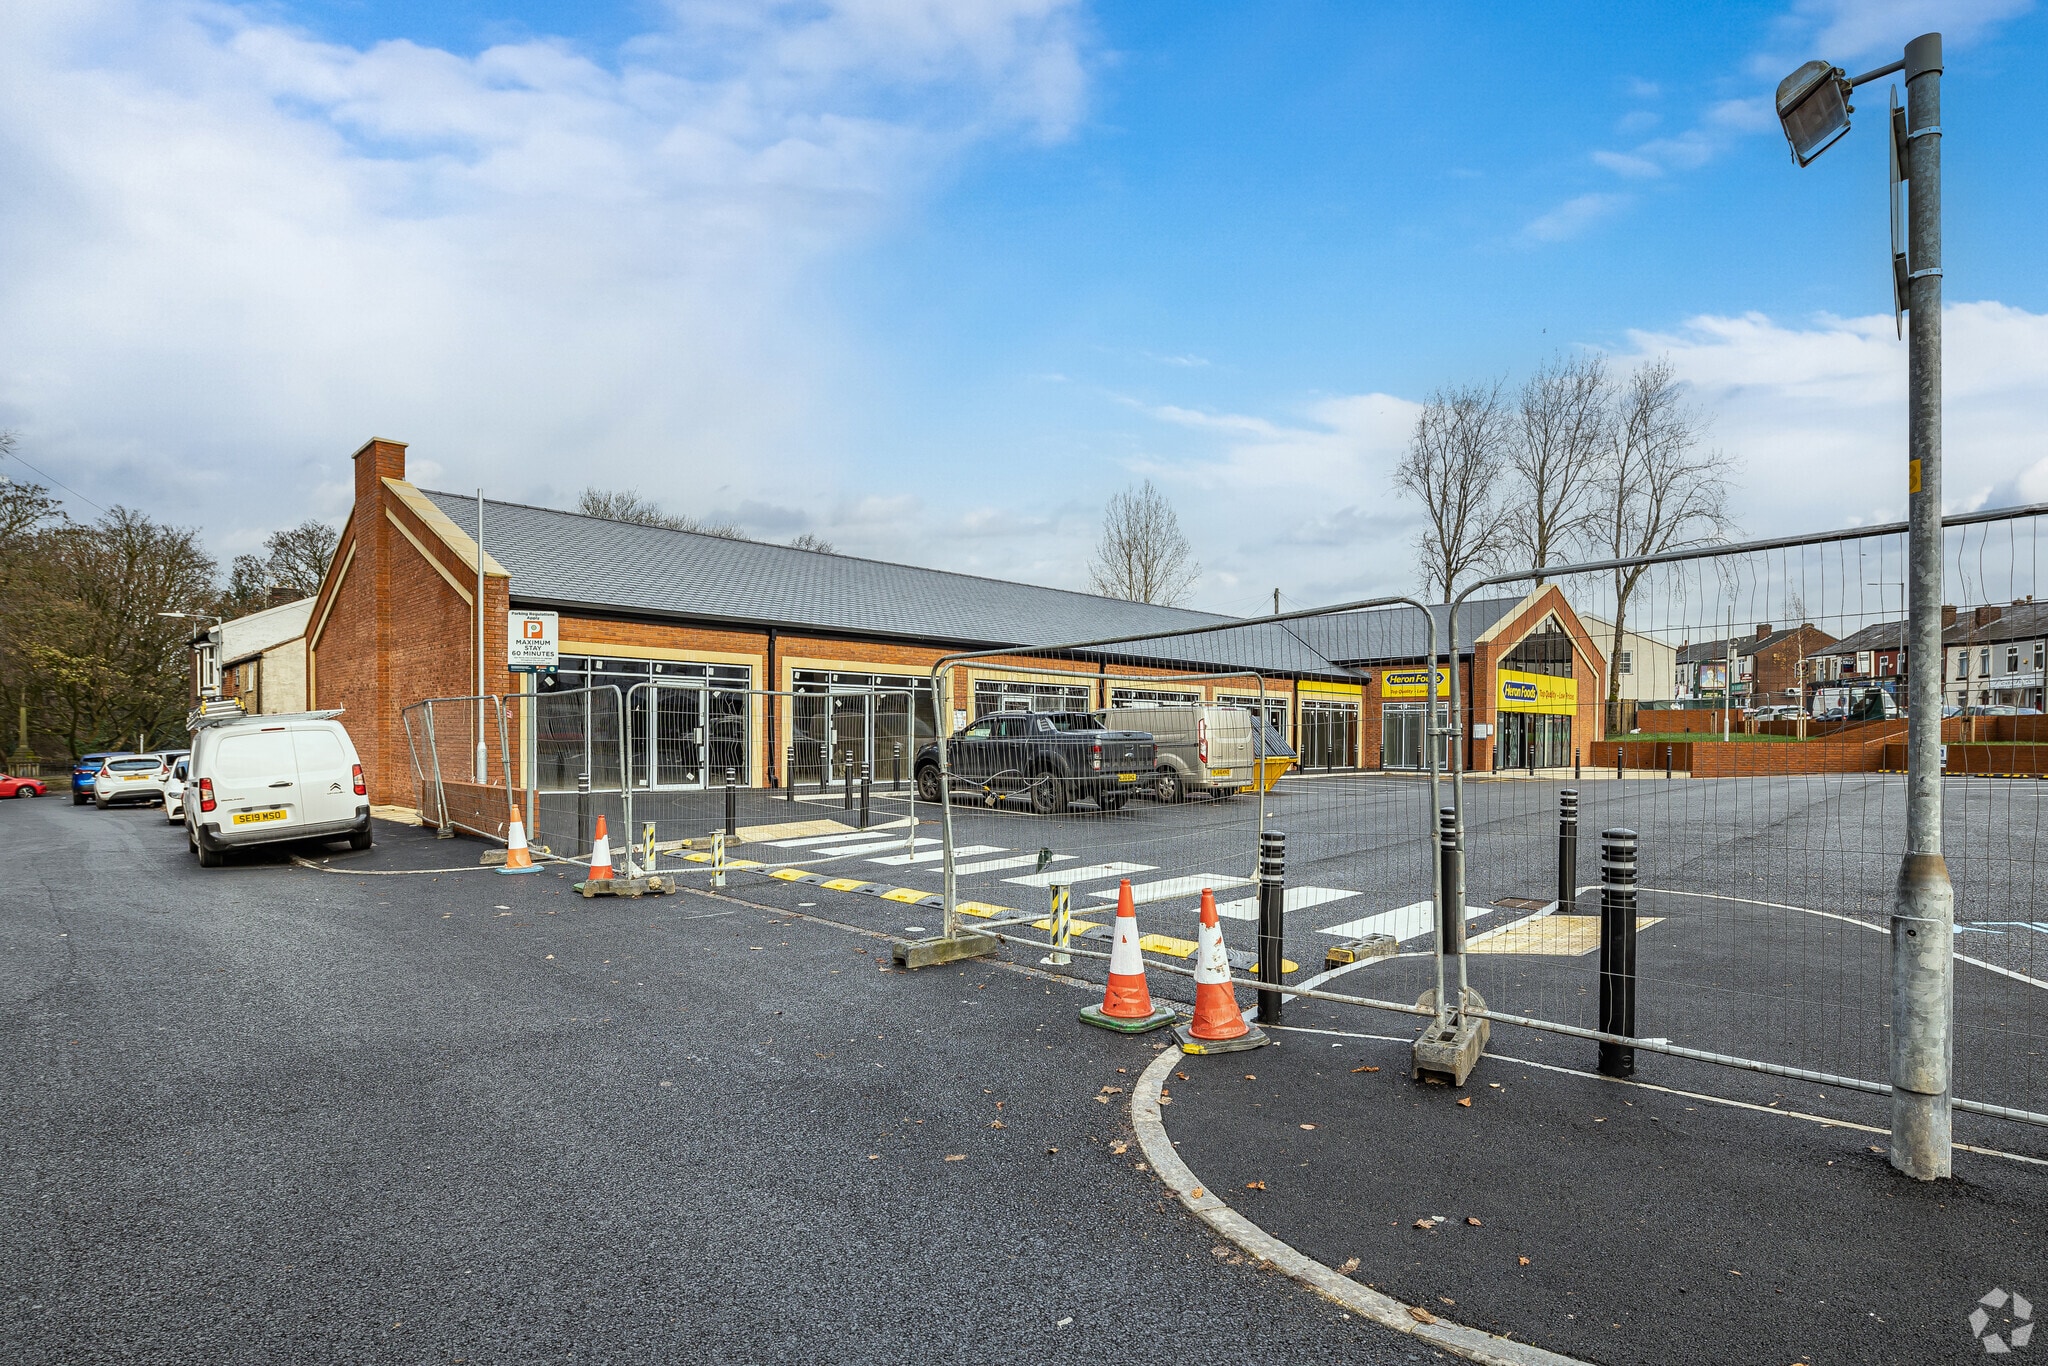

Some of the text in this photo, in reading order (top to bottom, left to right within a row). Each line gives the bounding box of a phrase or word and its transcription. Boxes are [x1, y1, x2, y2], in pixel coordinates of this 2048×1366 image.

[1389, 674, 1441, 683] Heron Foos
[1505, 683, 1536, 698] Heron Foods
[239, 813, 260, 823] SE19
